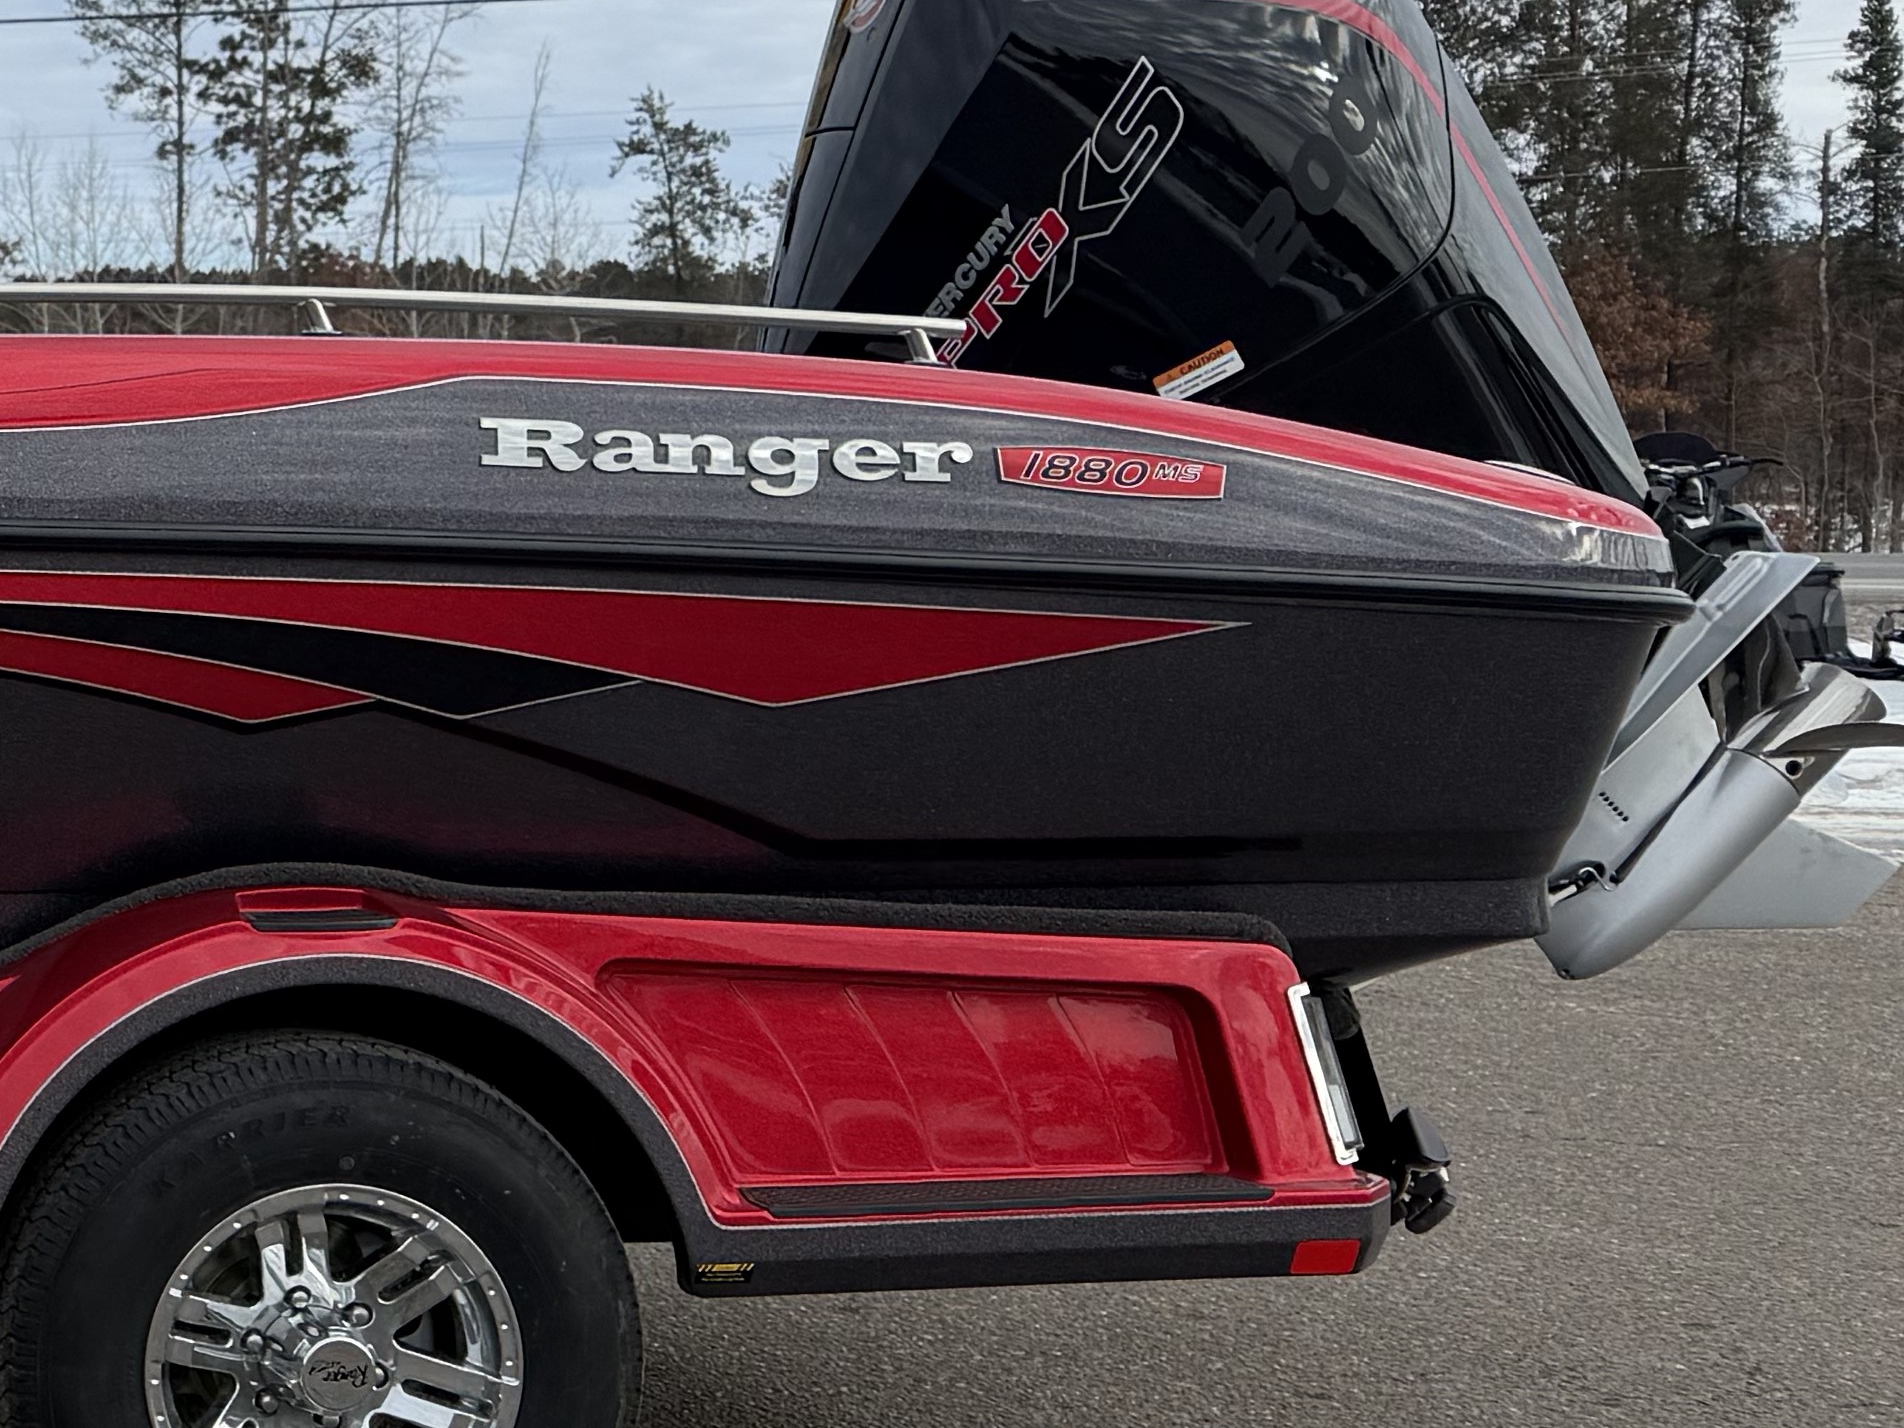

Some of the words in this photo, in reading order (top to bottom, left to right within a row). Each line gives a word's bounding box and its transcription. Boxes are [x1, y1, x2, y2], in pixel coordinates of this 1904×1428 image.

[1239, 75, 1378, 288] 200
[922, 204, 1016, 318] ERCURY
[1180, 348, 1224, 375] CAUTION
[479, 416, 974, 497] Ranger
[1020, 450, 1149, 488] 1880
[1153, 461, 1204, 483] MS
